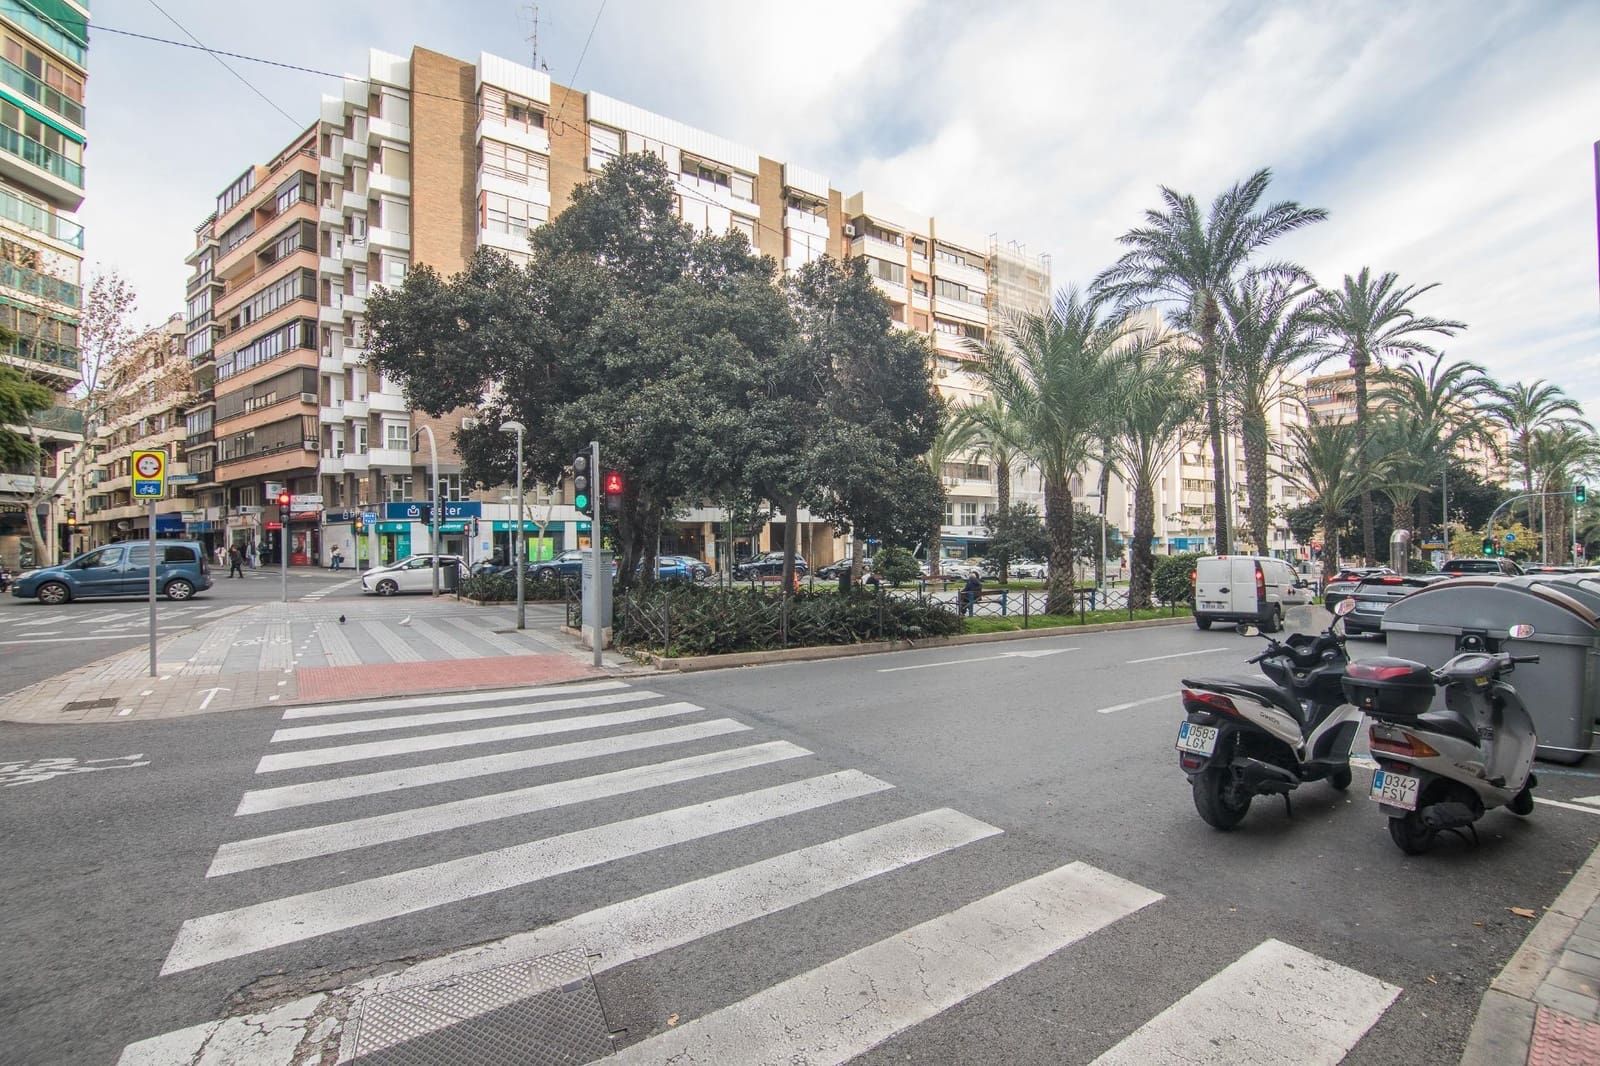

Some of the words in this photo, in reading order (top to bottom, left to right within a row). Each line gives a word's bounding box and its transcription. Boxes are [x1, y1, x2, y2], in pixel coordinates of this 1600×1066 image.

[1189, 725, 1216, 740] 0583
[1186, 736, 1206, 750] LGX
[1385, 774, 1416, 791] 0342
[1382, 787, 1406, 801] FSV
